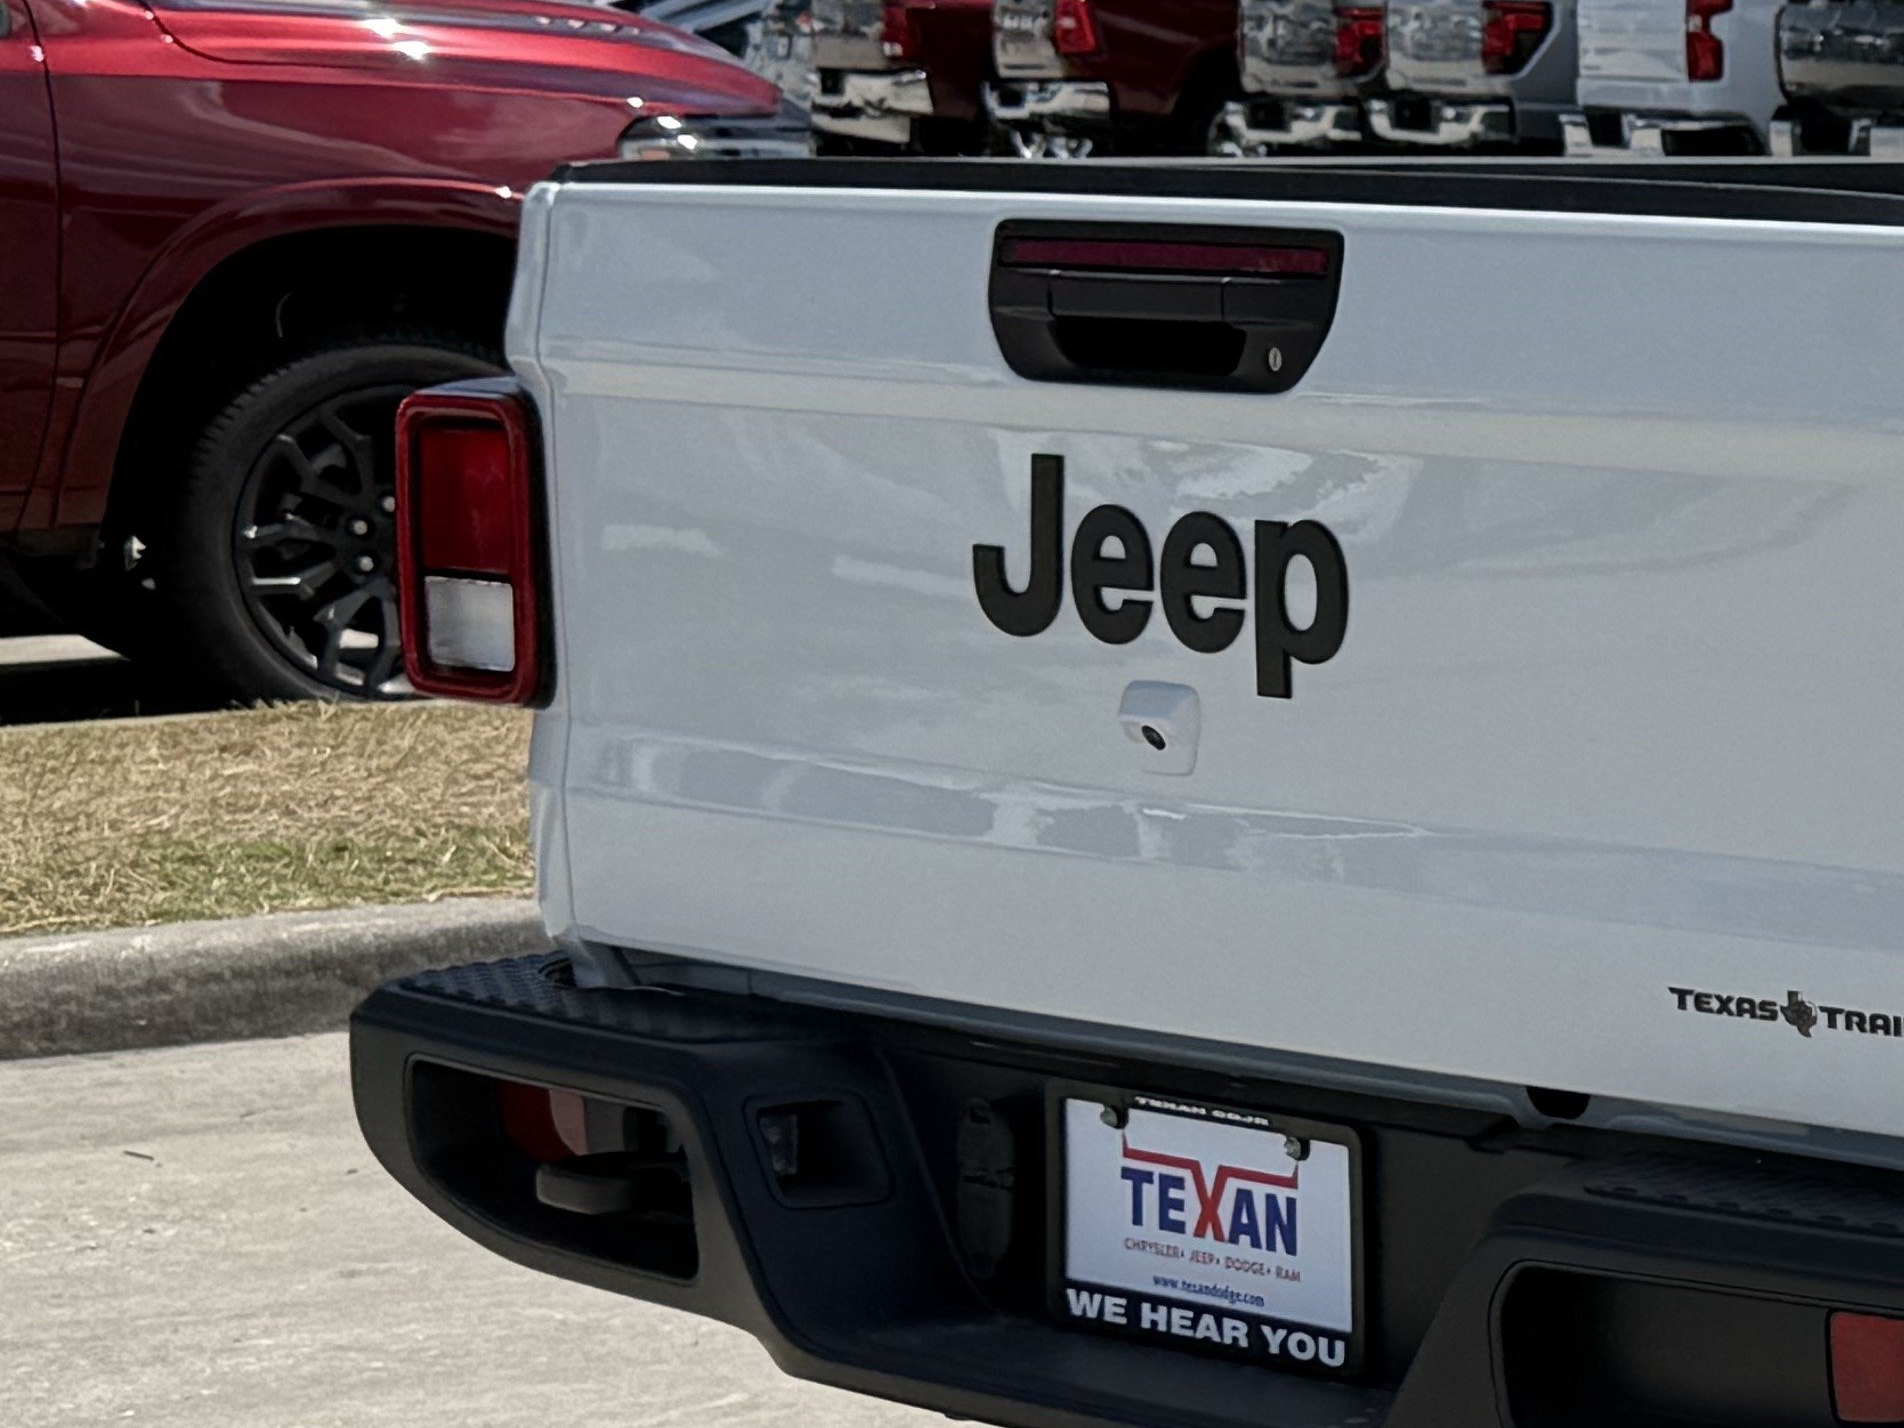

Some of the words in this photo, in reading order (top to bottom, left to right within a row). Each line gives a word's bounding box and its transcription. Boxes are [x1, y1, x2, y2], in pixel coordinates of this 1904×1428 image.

[971, 453, 1350, 699] Jeep
[1668, 987, 1779, 1021] TEXAS
[1120, 1133, 1299, 1257] TEXAN
[1066, 1288, 1127, 1325] WE
[1140, 1302, 1248, 1348] HEAR
[1261, 1324, 1345, 1367] YOU
